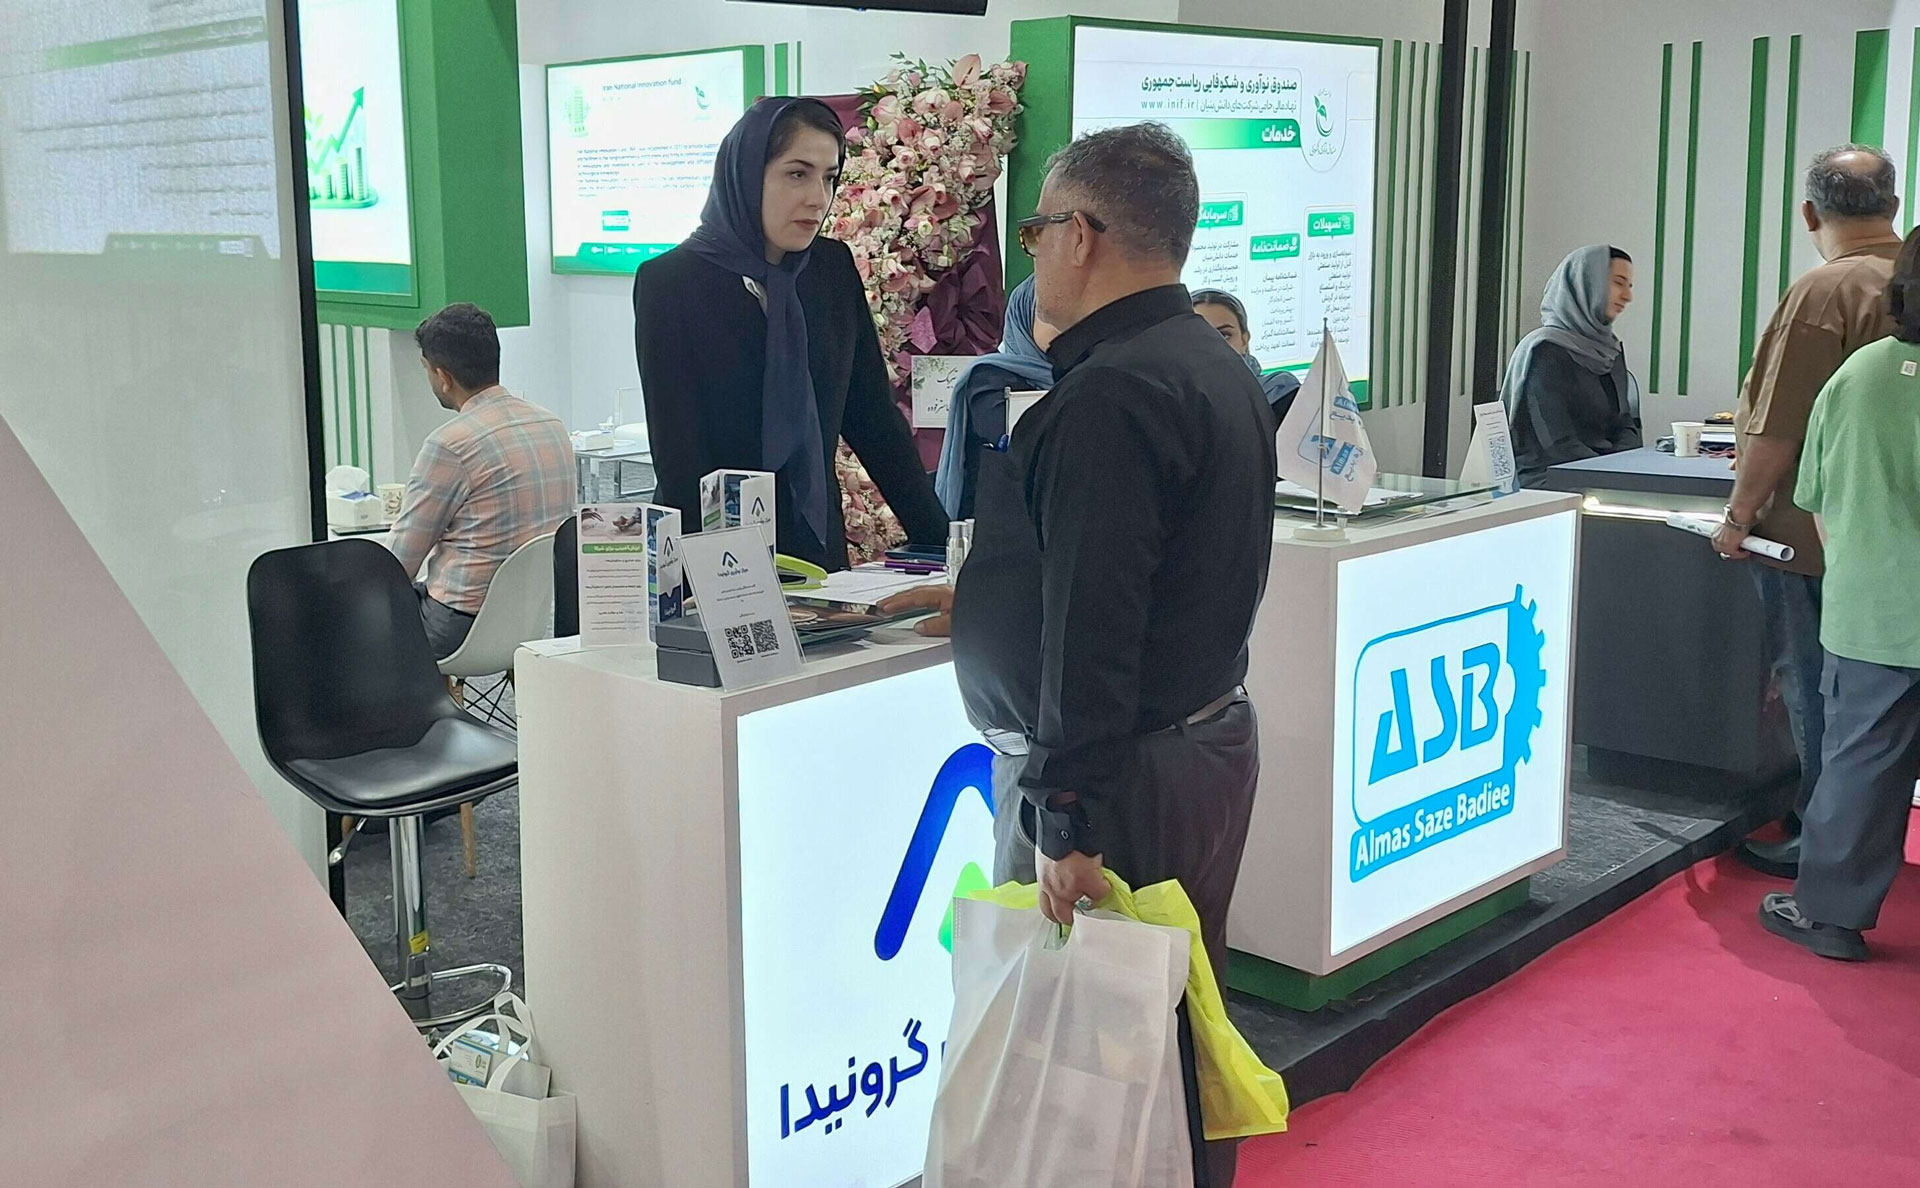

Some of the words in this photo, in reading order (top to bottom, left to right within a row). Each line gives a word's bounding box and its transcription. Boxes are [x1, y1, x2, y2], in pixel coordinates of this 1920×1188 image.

[1203, 73, 1239, 93] شکوفایی
[1240, 81, 1244, 93] و
[1246, 73, 1269, 94] نوآوری
[1271, 77, 1297, 94] صندوق
[1261, 124, 1296, 143] خدمات
[1313, 217, 1342, 232] تسهیلات
[1368, 642, 1500, 785] ASB
[1355, 827, 1411, 871] Almas
[1414, 808, 1453, 843] Saze
[1456, 781, 1511, 826] Badiee
[780, 1017, 929, 1140] گرونیدا
